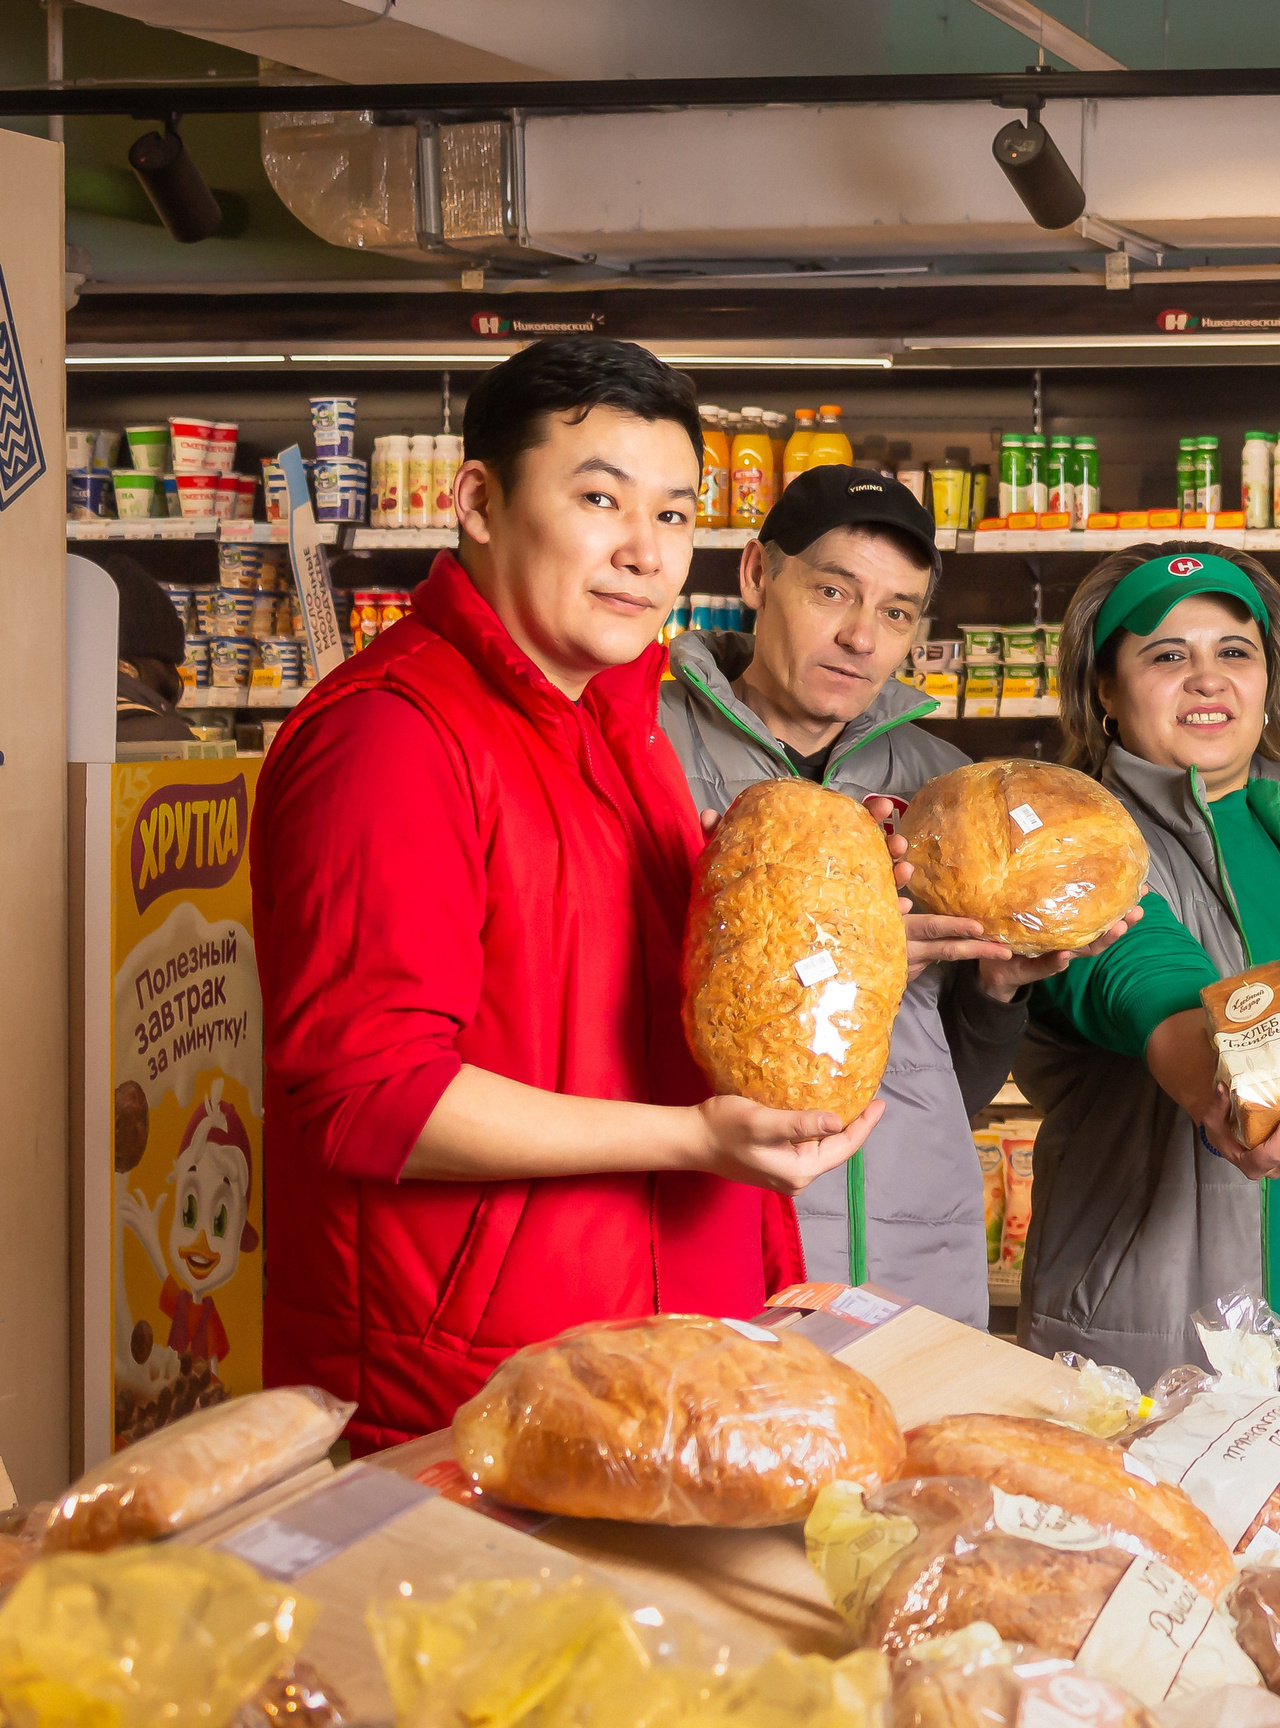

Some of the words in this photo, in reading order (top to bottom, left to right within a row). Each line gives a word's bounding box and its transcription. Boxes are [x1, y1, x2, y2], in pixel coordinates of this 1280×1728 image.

[513, 320, 594, 331] Николаевский
[139, 797, 239, 890] ХРУТКА
[135, 930, 237, 1010] Полезный
[134, 975, 227, 1055] завтрак
[1232, 989, 1265, 1011] Хлебный
[1240, 997, 1261, 1014] базар
[148, 1048, 168, 1081] за
[173, 1010, 248, 1063] минутку!
[1241, 1017, 1279, 1041] ХЛЕБ
